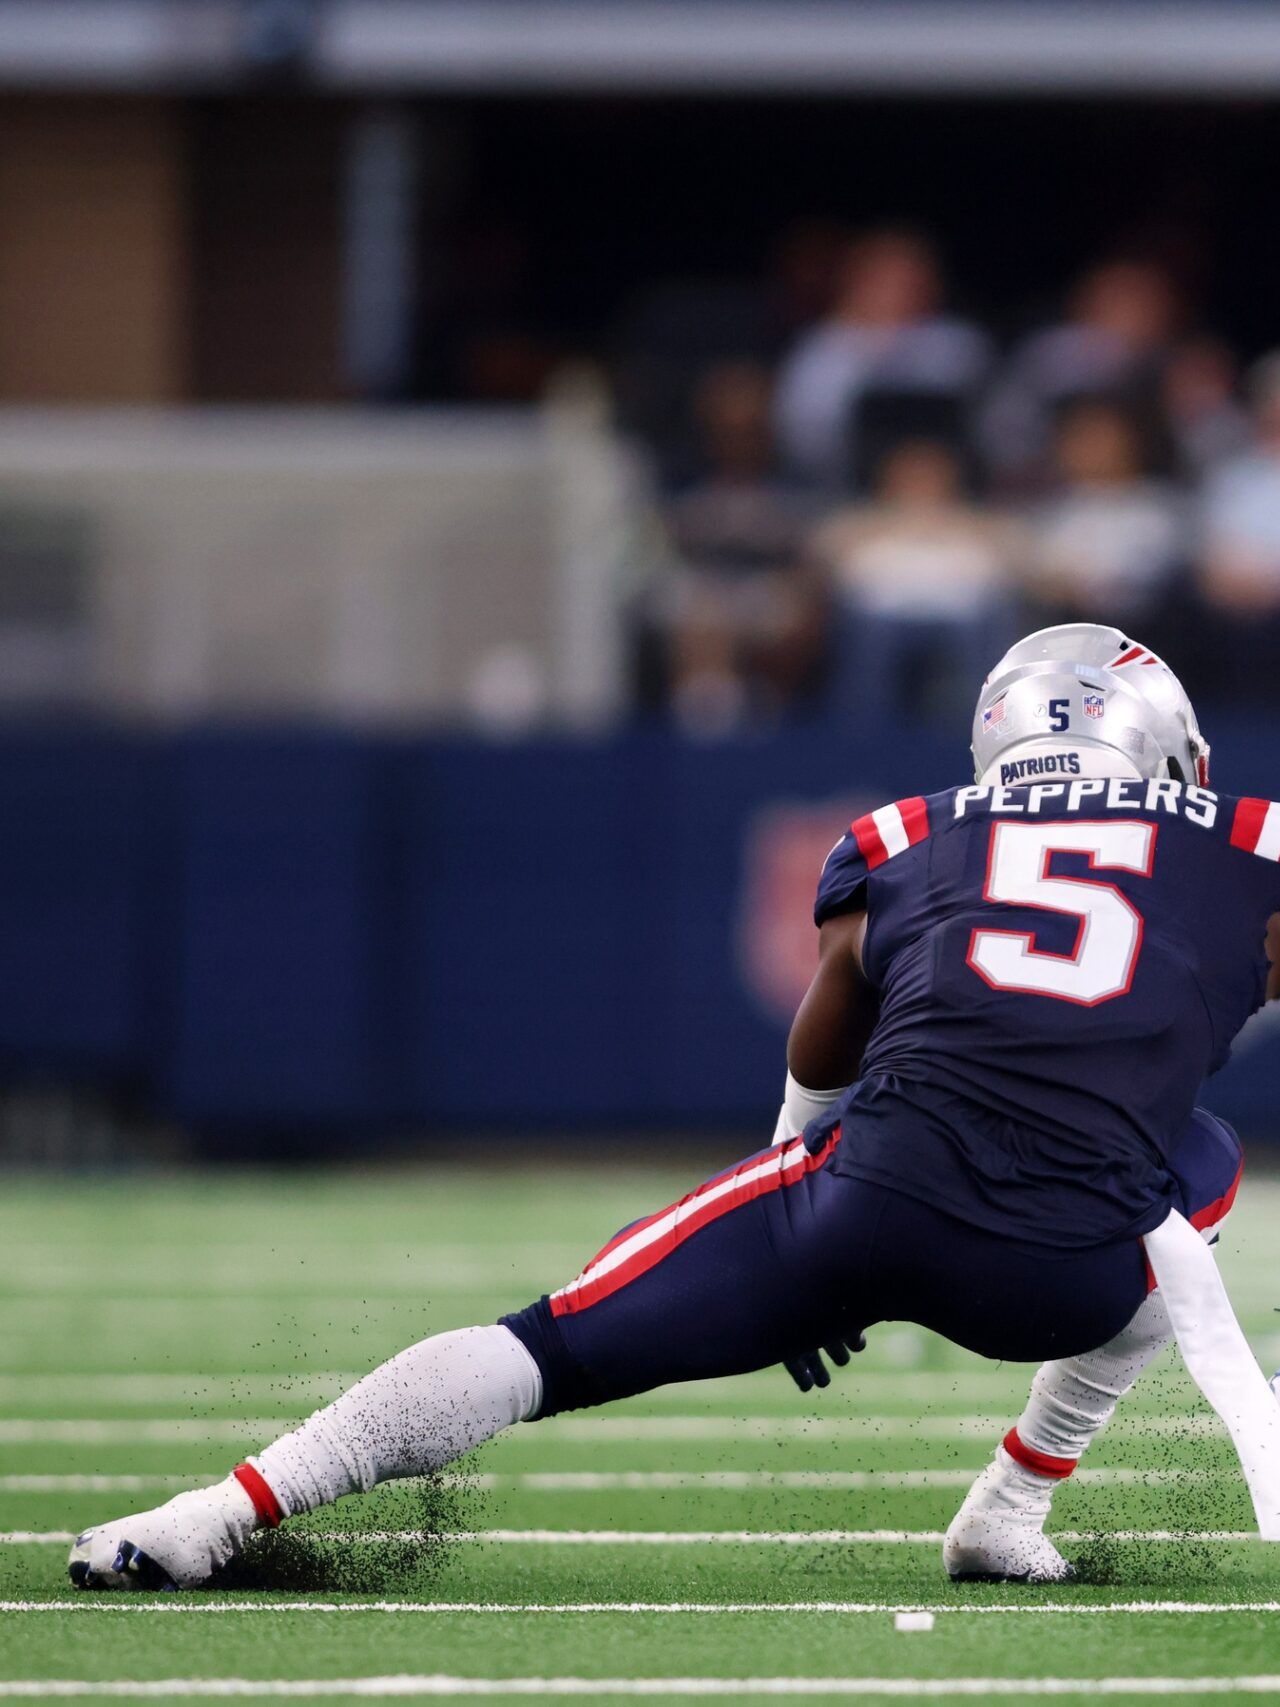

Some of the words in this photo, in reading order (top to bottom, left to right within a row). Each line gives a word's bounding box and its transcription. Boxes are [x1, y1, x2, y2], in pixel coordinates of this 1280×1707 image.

[1048, 698, 1070, 732] 5
[1000, 752, 1081, 787] PATRIOTS
[953, 778, 1219, 829] PEPPERS
[966, 819, 1159, 1008] 5
